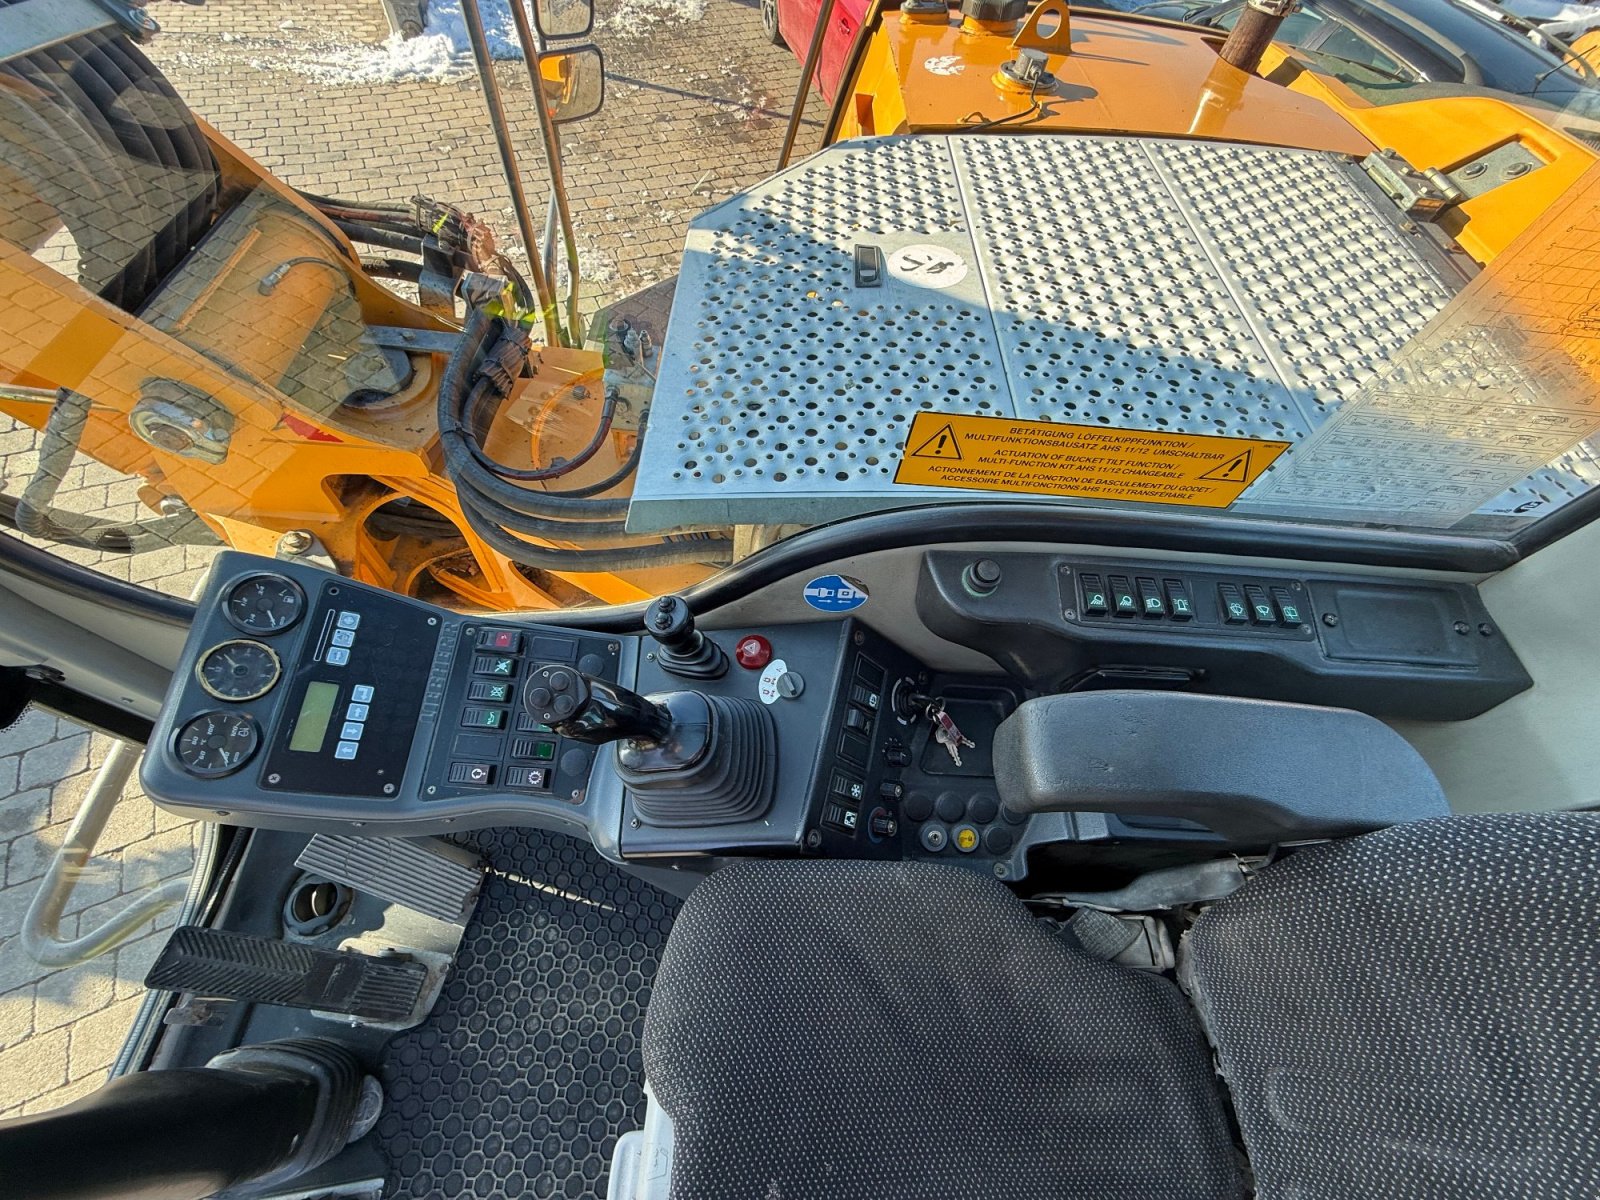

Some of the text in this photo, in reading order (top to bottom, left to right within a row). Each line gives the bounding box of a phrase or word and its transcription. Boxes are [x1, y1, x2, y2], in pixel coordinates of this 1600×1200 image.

[964, 433, 1225, 460] MULTIFUNKTIONSBAUSATZ AHS 11/12 UMSCHALTBAR
[1010, 427, 1074, 439] BETÄTIGUNG
[1078, 433, 1189, 448] LÖFFELKIPPFUNKTION
[977, 456, 1059, 468] MULTI-FUNCTION
[1098, 466, 1121, 474] 11/12
[1122, 468, 1186, 479] CHANGEABLE
[994, 449, 1053, 460] ACTUATION
[1065, 455, 1104, 464] BUCKET
[1105, 458, 1125, 466] TILT
[1125, 460, 1174, 470] FUNCTION
[928, 465, 1002, 477] ACTIONNEMENT
[1032, 473, 1080, 483] FONCTION
[1094, 478, 1164, 489] BASCULEMENT
[1178, 485, 1211, 493] GODET
[940, 474, 1001, 485] ACCESSOIRE
[1000, 479, 1080, 491] MULTIFONCTIONS
[1102, 487, 1125, 495] 11/12
[419, 621, 459, 723] LIEBHERR
